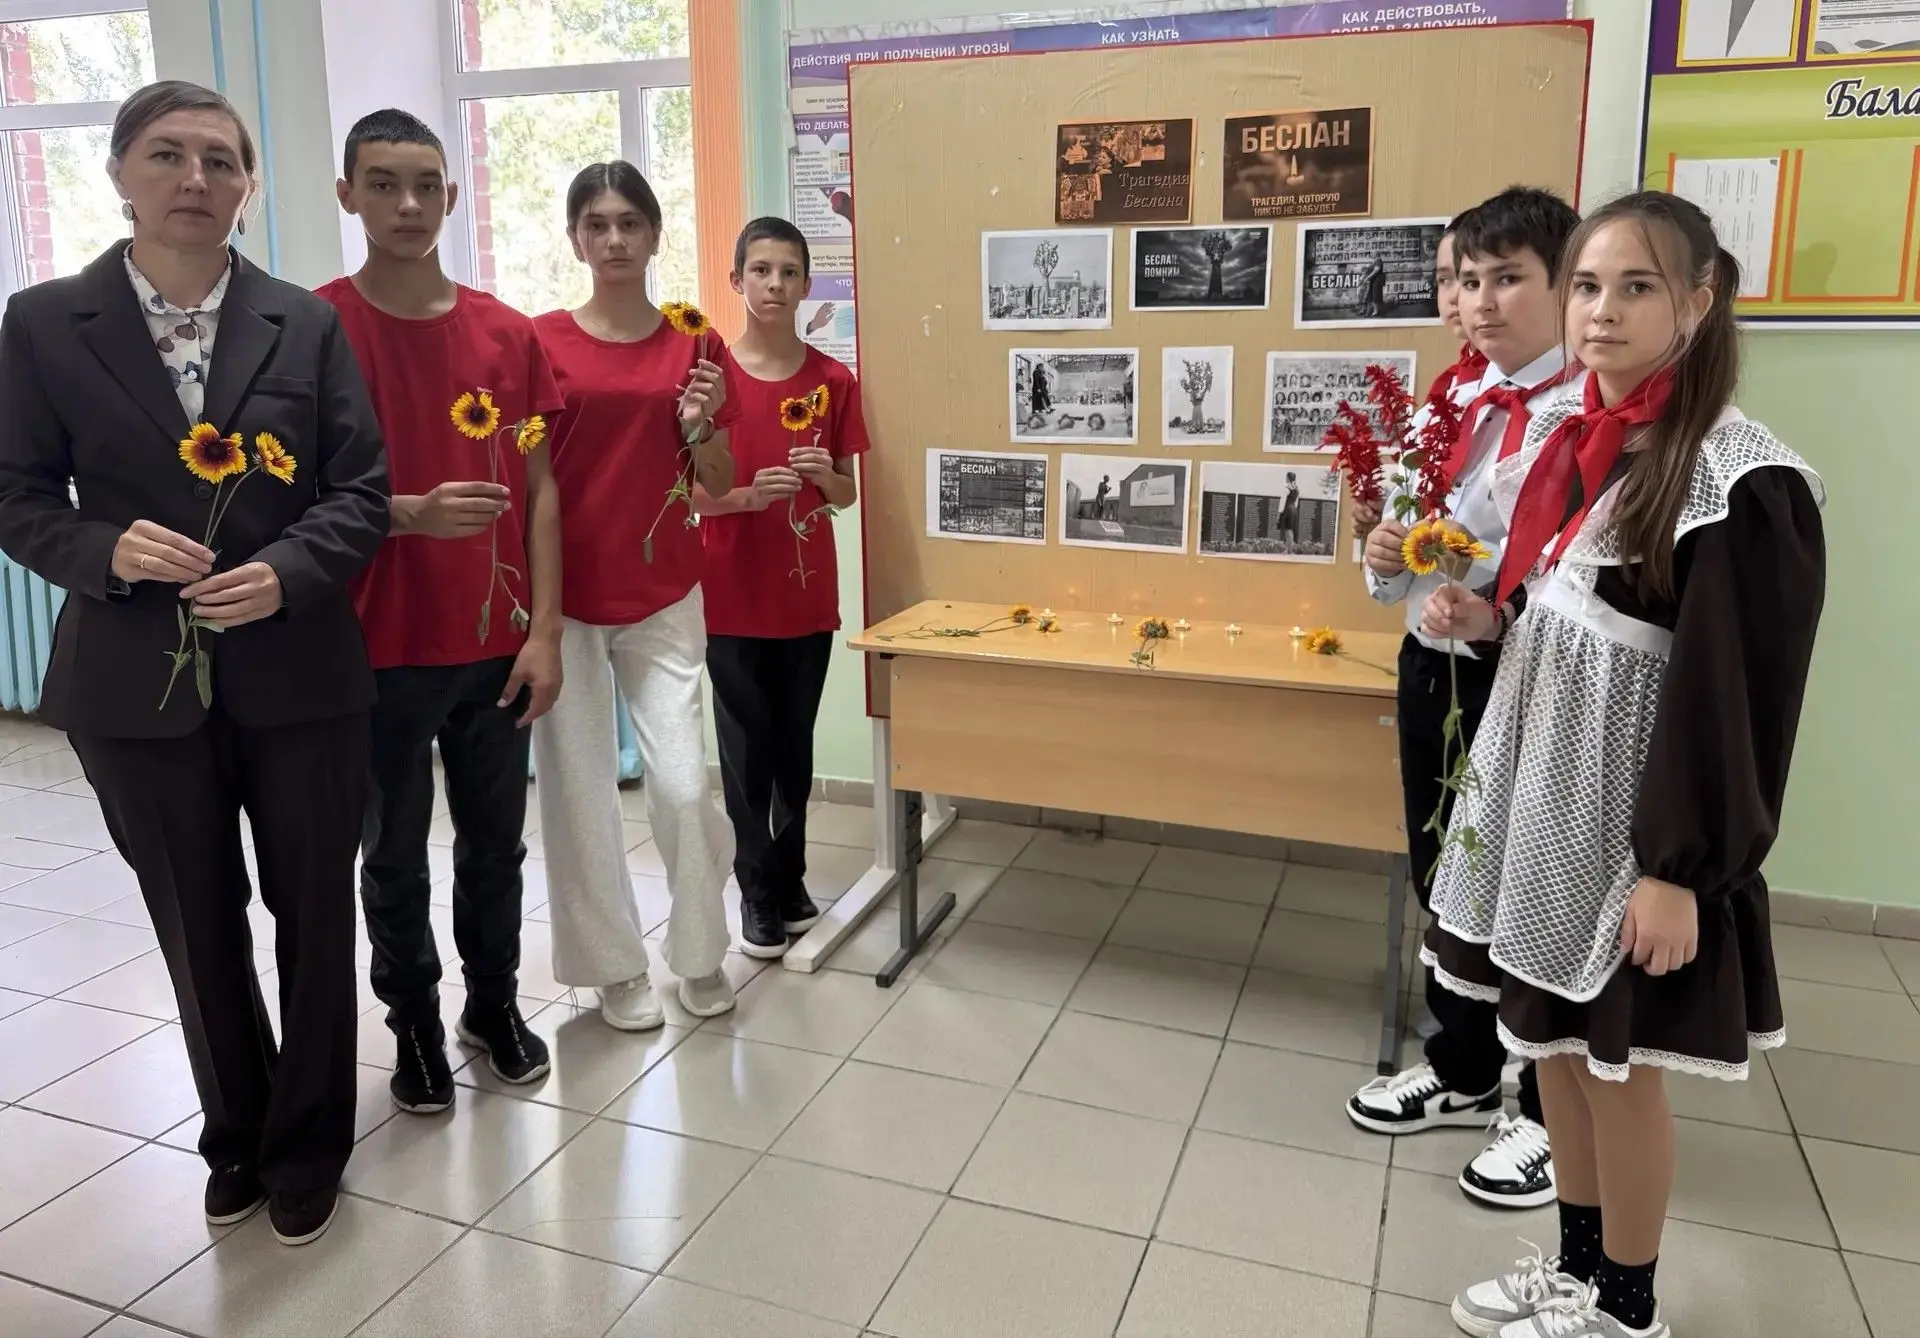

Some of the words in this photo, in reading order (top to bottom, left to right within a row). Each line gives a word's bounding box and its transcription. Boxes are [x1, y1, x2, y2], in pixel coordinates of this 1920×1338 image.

[1342, 11, 1370, 25] КАК
[1375, 3, 1486, 23] ДЕЙСТВОВАТЬ,
[1101, 31, 1125, 45] КАК
[1131, 28, 1179, 42] УЗНАТЬ
[793, 53, 851, 69] ДЕЙСТВИЯ
[856, 51, 879, 62] ПРИ
[884, 46, 956, 61] ПОЛУЧЕНИИ
[961, 41, 1010, 56] УГРОЗЫ
[1825, 77, 1920, 119] Бала
[814, 121, 849, 131] ДЕЛАТЬ
[1242, 120, 1351, 153] БЕСЛАН
[1119, 172, 1191, 190] Трагедия
[1123, 194, 1184, 208] Беслана
[1299, 192, 1340, 204] КОТОРУЮ
[1254, 205, 1281, 217] НИКТО
[1284, 205, 1295, 215] НЕ
[1296, 202, 1336, 214] ЗАБУДЕТ
[1144, 266, 1180, 279] ПОМНИМ
[836, 279, 852, 287] ЧТО
[1312, 273, 1360, 289] БЕСЛАН
[961, 463, 996, 475] БЕСЛАН
